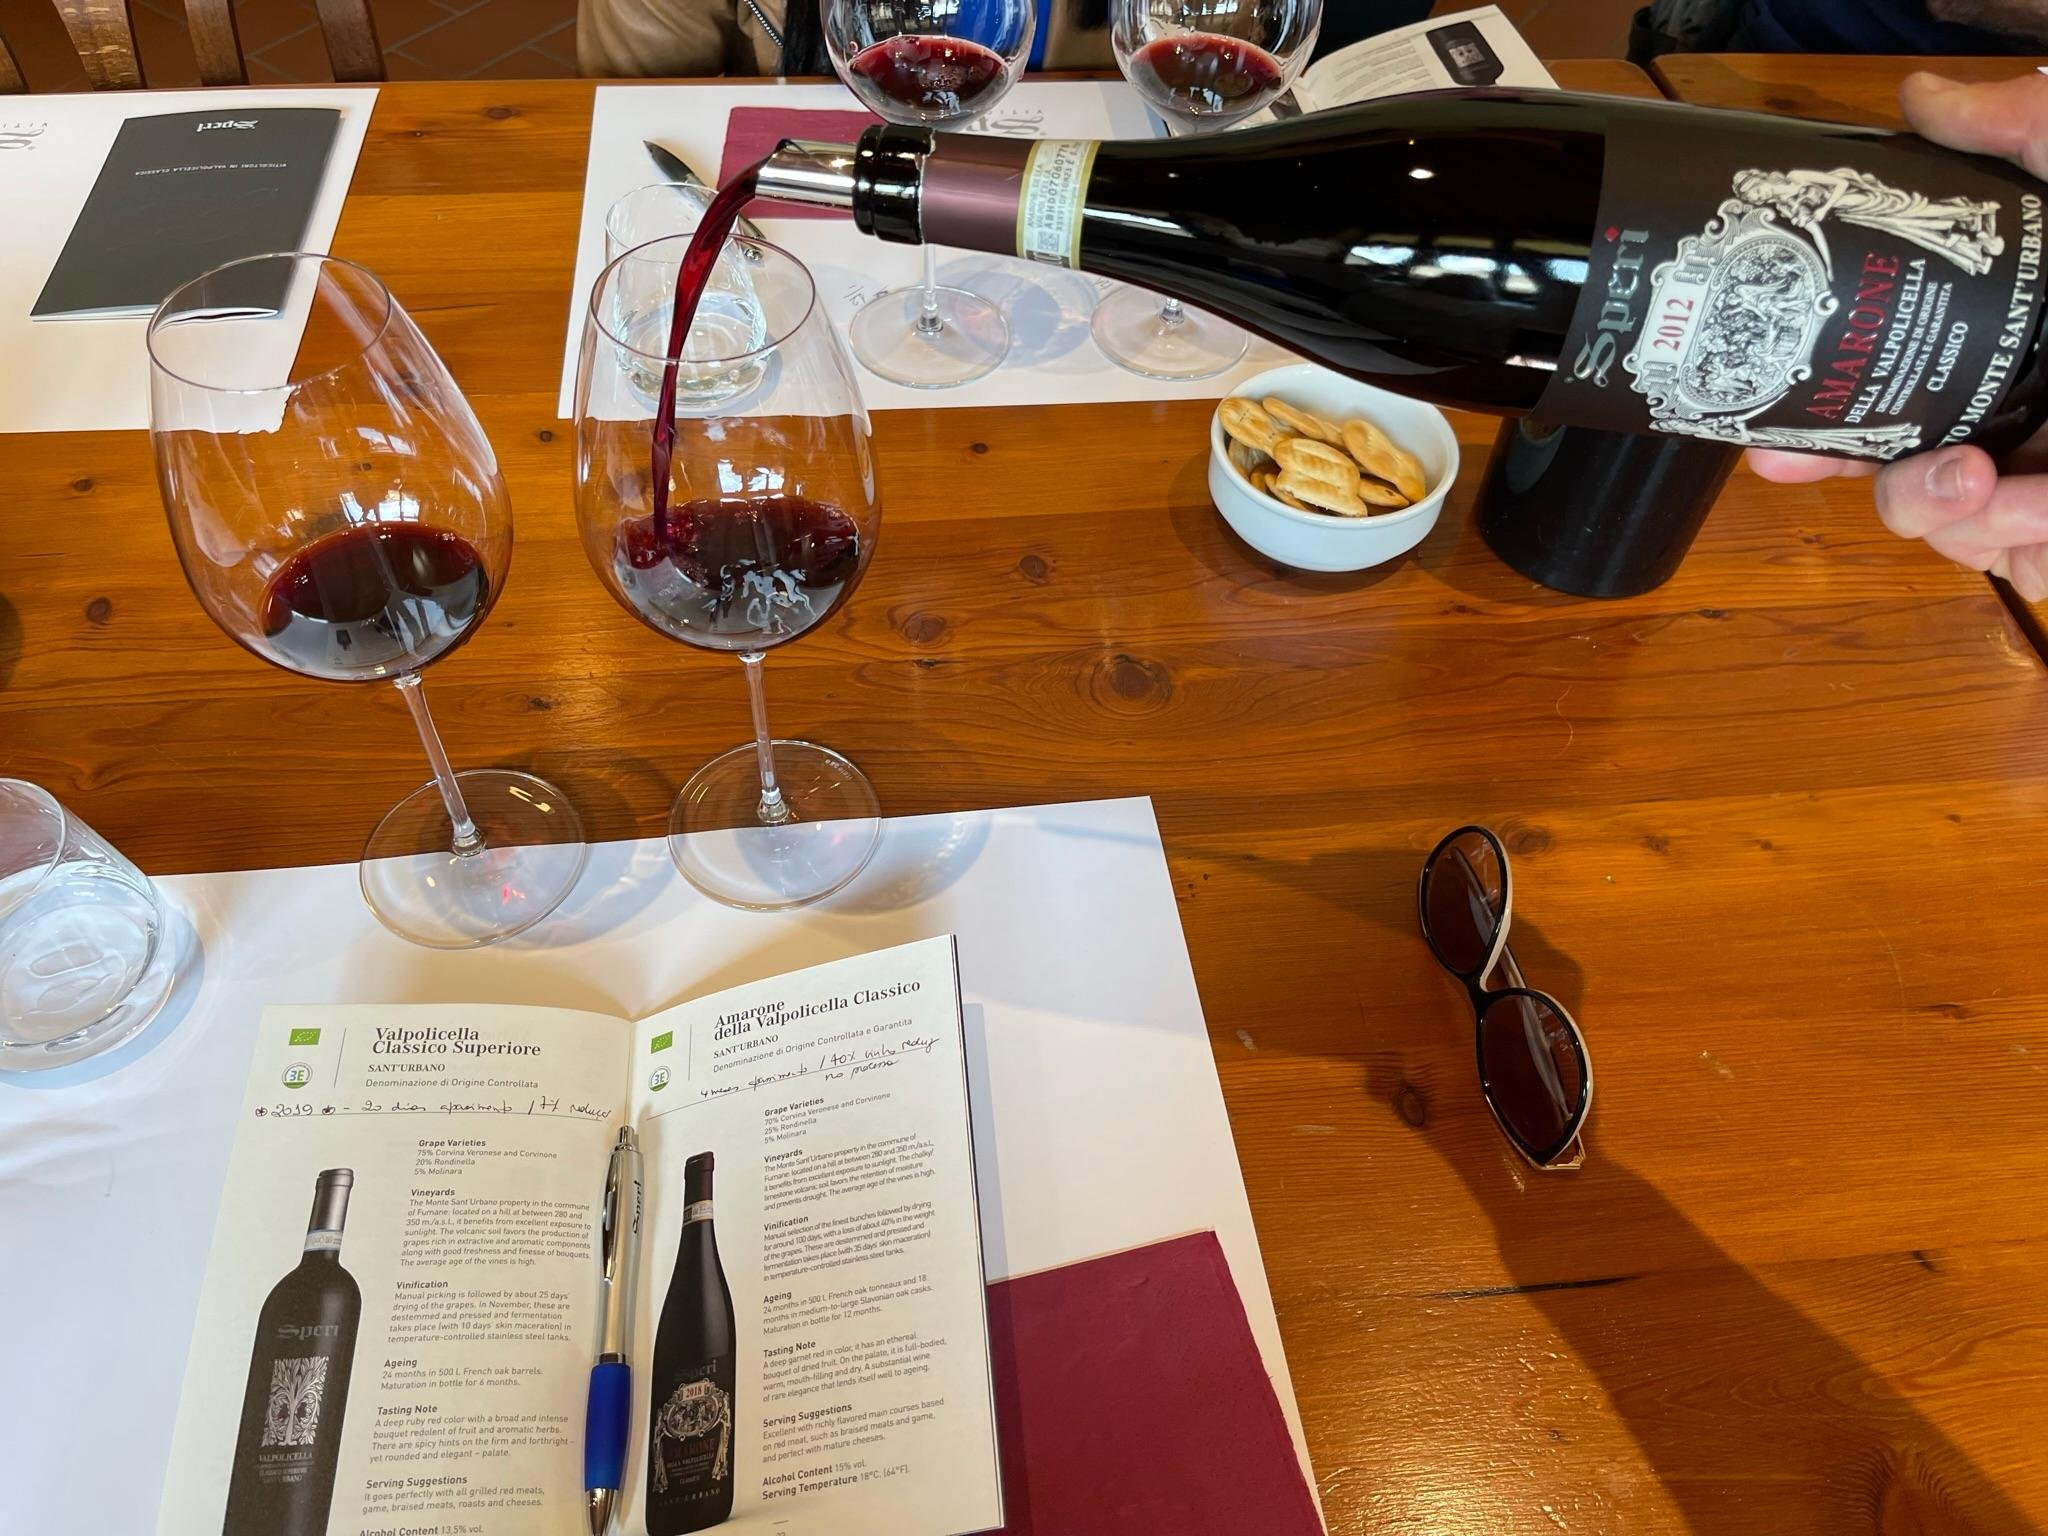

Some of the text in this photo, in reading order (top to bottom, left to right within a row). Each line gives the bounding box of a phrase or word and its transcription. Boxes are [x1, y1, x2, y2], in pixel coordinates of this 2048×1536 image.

[1574, 226, 1649, 388] Speri
[1959, 193, 2044, 424] MONTE SANT'URBANO
[1653, 299, 1694, 351] 2012
[1806, 252, 1899, 419] AMARONE
[1844, 258, 1926, 423] DELLA VALPOLICELLA
[1875, 281, 1938, 413] DENOMINAZIONE DI ORIGINE
[1889, 352, 1927, 415] CONTROLLATA
[1925, 282, 1953, 343] GARANTITA
[1926, 320, 1968, 391] CLASSICO
[714, 981, 920, 1041] della Valpolicella Classico
[715, 1001, 784, 1027] Amarone
[376, 1028, 479, 1042] Valpolicella
[373, 1041, 541, 1056] Classico Superiore
[714, 1052, 773, 1072] Denominazione
[776, 1047, 784, 1056] di
[785, 1041, 815, 1053] Origine
[818, 1030, 864, 1045] Controllata
[873, 1019, 912, 1032] Garantita
[714, 1035, 778, 1058] SANT'URBANO
[290, 1070, 304, 1081] 3E
[368, 1064, 445, 1072] SANT'URBANO
[366, 1078, 538, 1088] Denominazione di Origine Controllata
[271, 1104, 313, 1117] 2019
[764, 1093, 890, 1126] 70% Corvina Veronese and Corvinone
[765, 1098, 824, 1116] Grape Varieties
[780, 1118, 817, 1131] Rondinella
[418, 1140, 445, 1148] Grape
[764, 1130, 806, 1144] 5% Molinara
[417, 1148, 435, 1157] 75%
[466, 1148, 501, 1156] Veronese
[520, 1150, 557, 1159] Corvinone
[764, 1149, 802, 1163] Vineyards
[412, 1189, 455, 1197] Vineyards
[764, 1217, 808, 1231] Vinification
[397, 1281, 448, 1289] Vinification
[763, 1292, 792, 1304] Ageing
[763, 1314, 790, 1324] months
[799, 1300, 859, 1316] medium-to-large
[860, 1293, 894, 1304] Slavonian
[895, 1288, 909, 1298] oak
[763, 1322, 800, 1335] Maturation
[810, 1316, 830, 1325] bottle
[764, 1341, 816, 1357] Tasting Note
[384, 1359, 417, 1369] Ageing
[382, 1370, 392, 1379] 24
[394, 1370, 426, 1378] months
[428, 1368, 436, 1377] in
[438, 1368, 454, 1377] 500
[463, 1367, 492, 1377] French
[494, 1366, 509, 1375] oak
[381, 1381, 426, 1390] Maturation
[429, 1380, 437, 1388] in
[439, 1379, 463, 1388] bottle
[465, 1378, 477, 1386] for
[479, 1378, 484, 1386] 6
[378, 1405, 438, 1416] Tasting Note
[763, 1404, 852, 1428] Serving Suggestions
[762, 1453, 776, 1463] and
[778, 1448, 804, 1462] perfect
[805, 1445, 822, 1454] with
[823, 1440, 850, 1451] mature
[366, 1476, 467, 1489] Serving Suggestions
[763, 1472, 795, 1486] Alcohol
[798, 1465, 832, 1479] Content
[372, 1493, 393, 1502] goes
[395, 1490, 434, 1501] perfectly
[435, 1488, 454, 1497] with
[456, 1487, 467, 1496] all
[469, 1486, 498, 1498] grilled
[499, 1486, 514, 1495] red
[763, 1487, 796, 1500] Serving
[800, 1476, 857, 1492] Temperature
[392, 1502, 424, 1512] braised
[487, 1498, 504, 1507] and
[398, 1527, 438, 1536] Content
